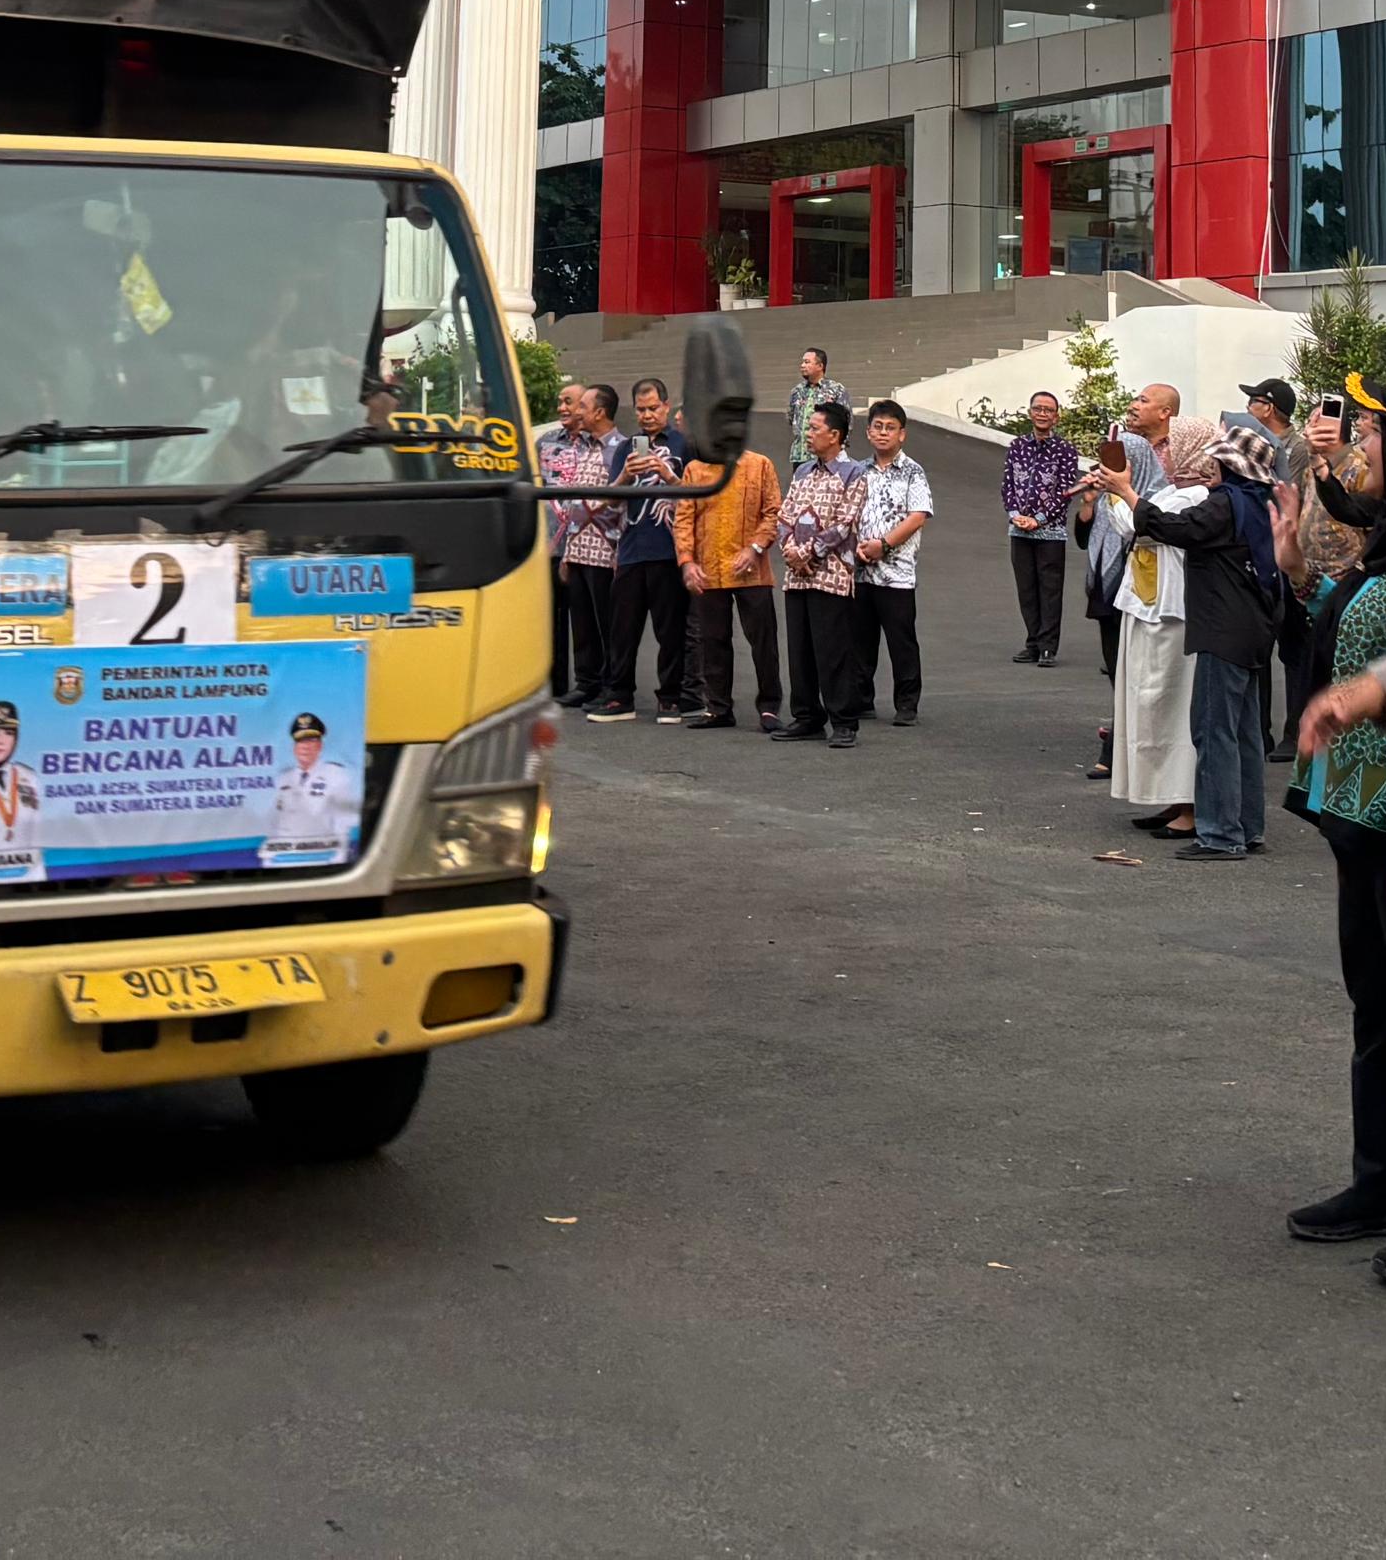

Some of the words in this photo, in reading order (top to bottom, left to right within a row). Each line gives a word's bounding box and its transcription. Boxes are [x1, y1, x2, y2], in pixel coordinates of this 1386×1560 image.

[453, 455, 521, 472] GROUP
[289, 564, 386, 594] UTARA
[129, 552, 186, 645] 2
[101, 666, 218, 681] PEMERINTAH
[223, 664, 270, 678] KOTA
[102, 686, 177, 701] BANDAR
[182, 683, 269, 700] LAMPUNG
[84, 714, 238, 742] BANTUAN
[41, 749, 185, 775] BENCANA
[194, 745, 274, 769] ALAM
[45, 783, 94, 798] BANDA
[145, 778, 223, 794] SUMATERA
[227, 776, 275, 790] UTARA
[74, 799, 107, 815] DAN
[110, 797, 192, 813] SUMATERA
[196, 794, 245, 810] BARAT
[65, 974, 96, 1004] Z
[122, 964, 219, 999] 9075
[260, 956, 316, 986] TA
